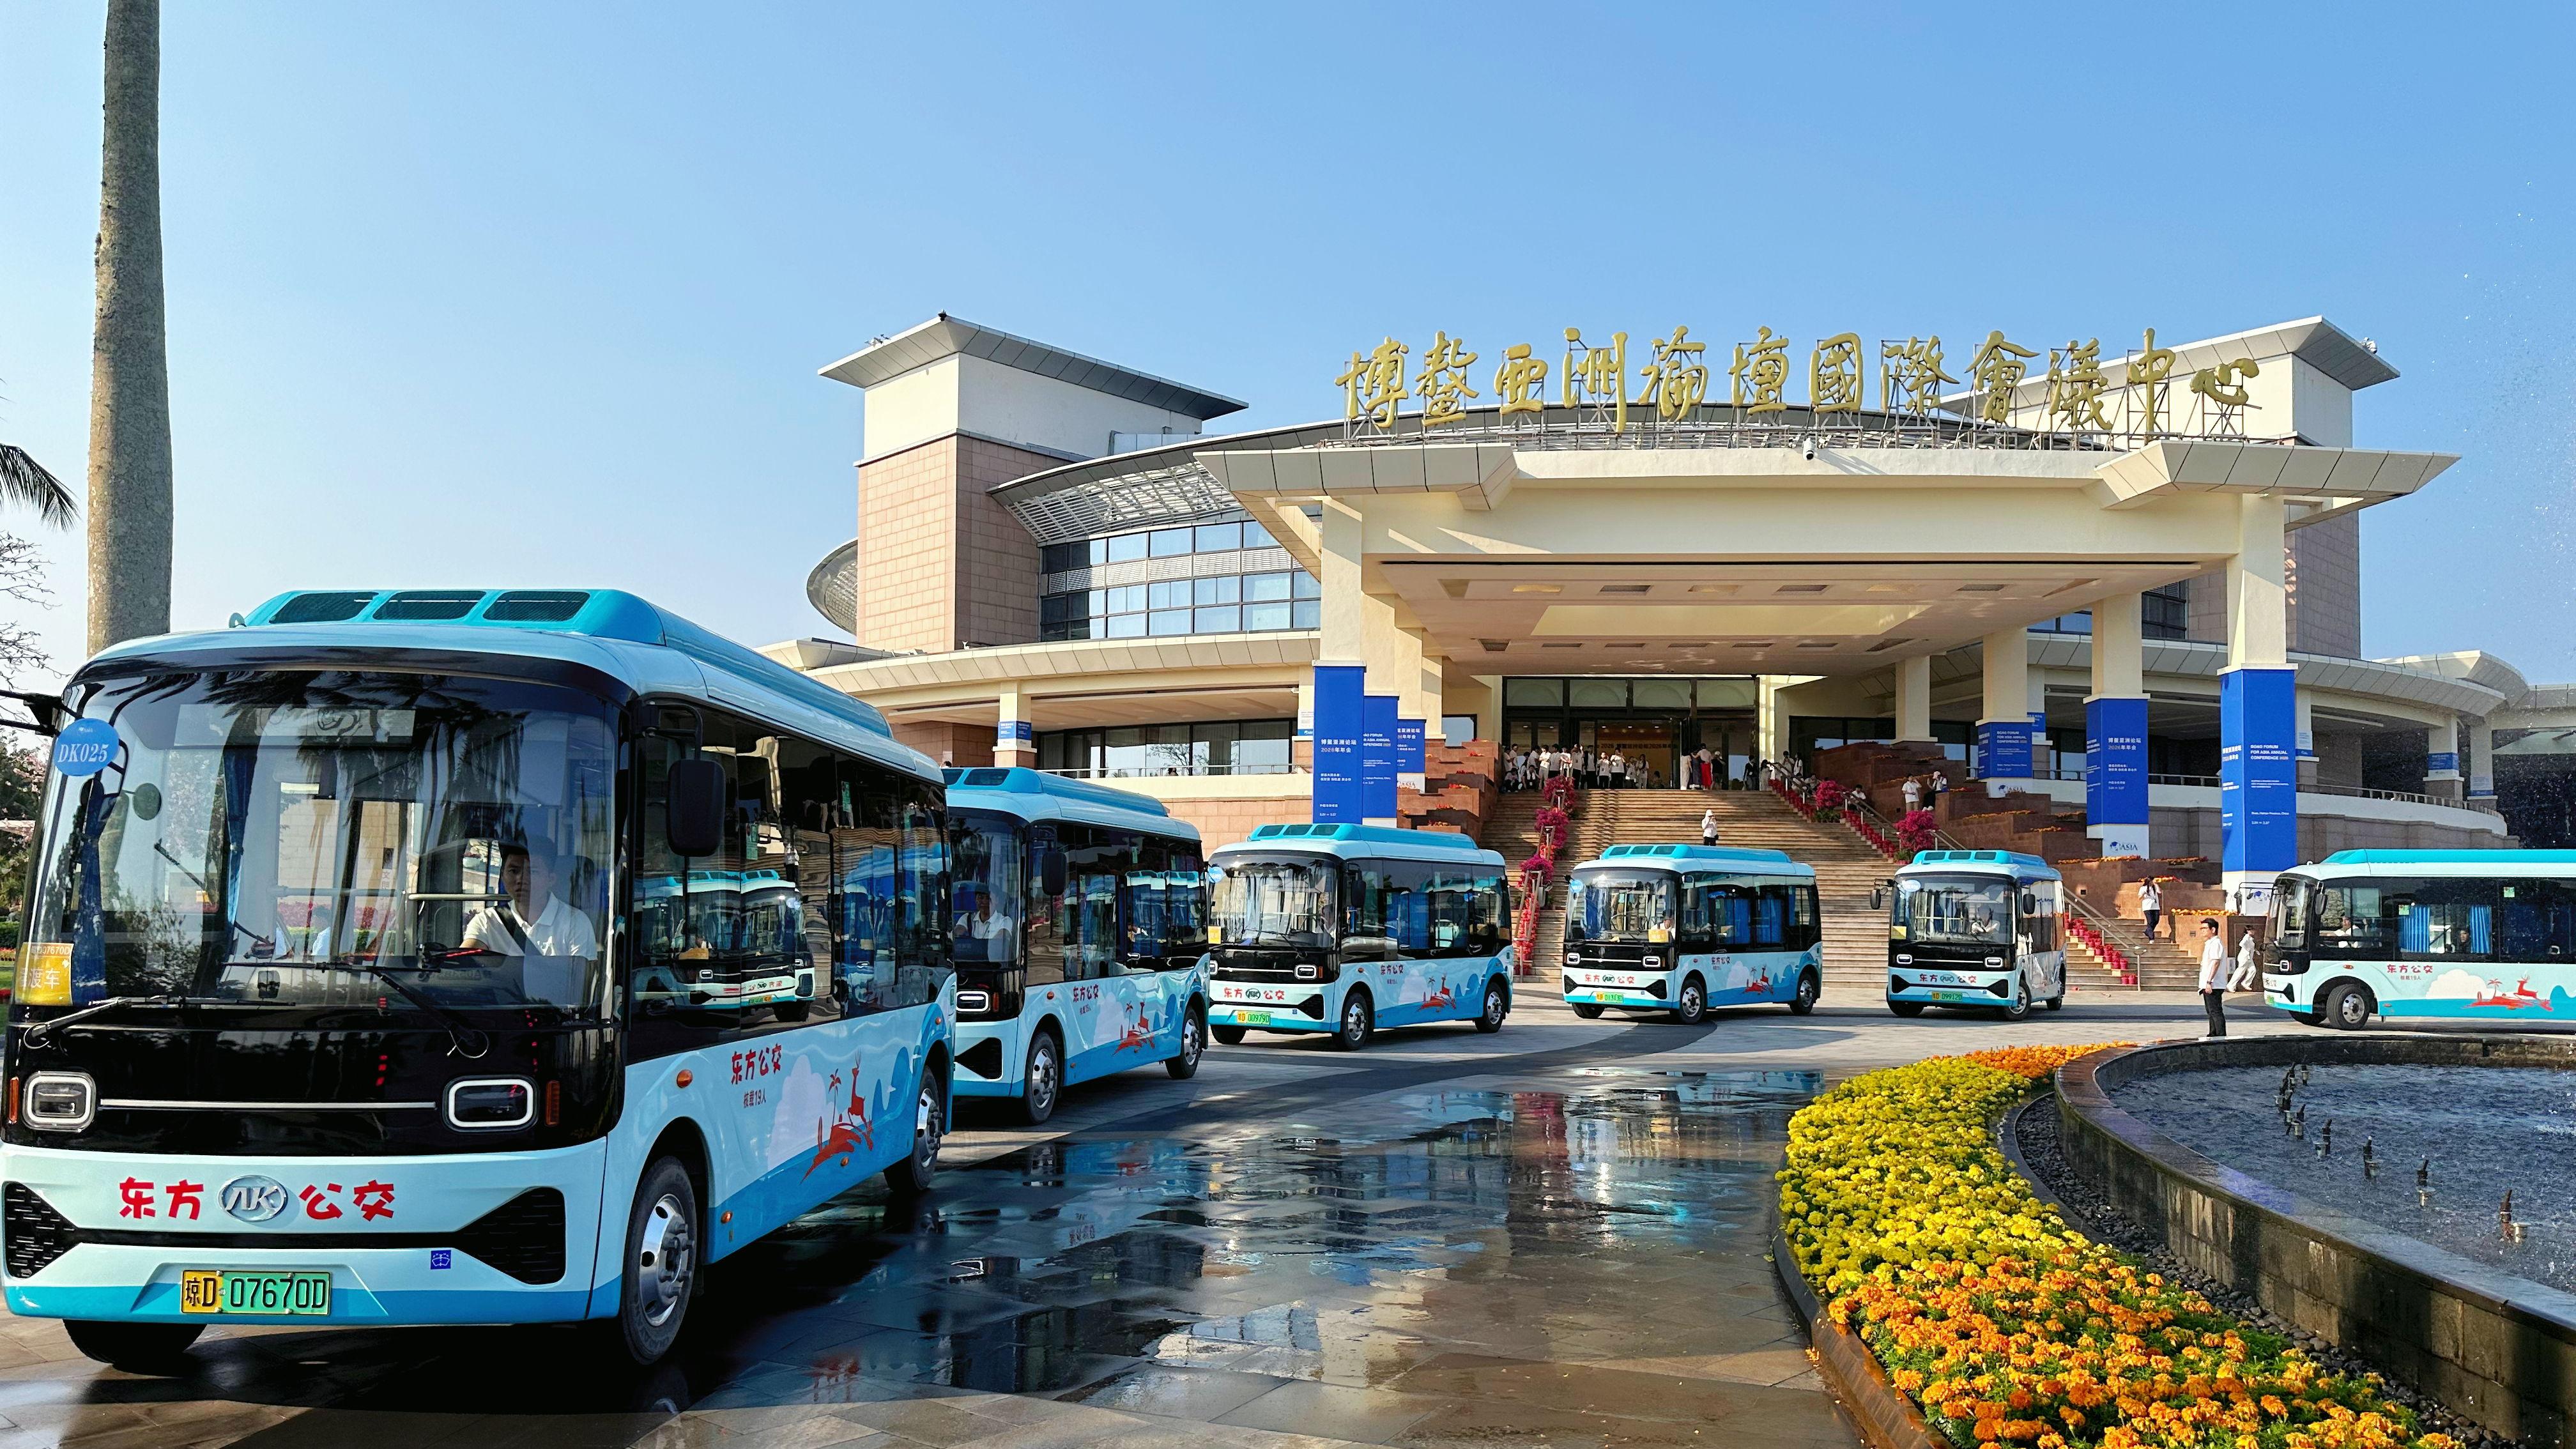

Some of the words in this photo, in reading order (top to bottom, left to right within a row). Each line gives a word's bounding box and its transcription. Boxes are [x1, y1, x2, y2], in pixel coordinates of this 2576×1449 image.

[57, 744, 109, 763] DK025
[1585, 974, 1600, 983] 东方
[1919, 973, 1938, 983] 东方
[2387, 964, 2434, 974] 东方公交
[1073, 984, 1099, 1003] 东方公交
[1223, 986, 1243, 999] 东方
[1264, 989, 1285, 1000] 公交
[731, 1043, 781, 1085] 东方公交
[119, 1176, 204, 1220] 东方
[299, 1179, 395, 1221] 公交
[230, 1277, 326, 1308] 07670D
